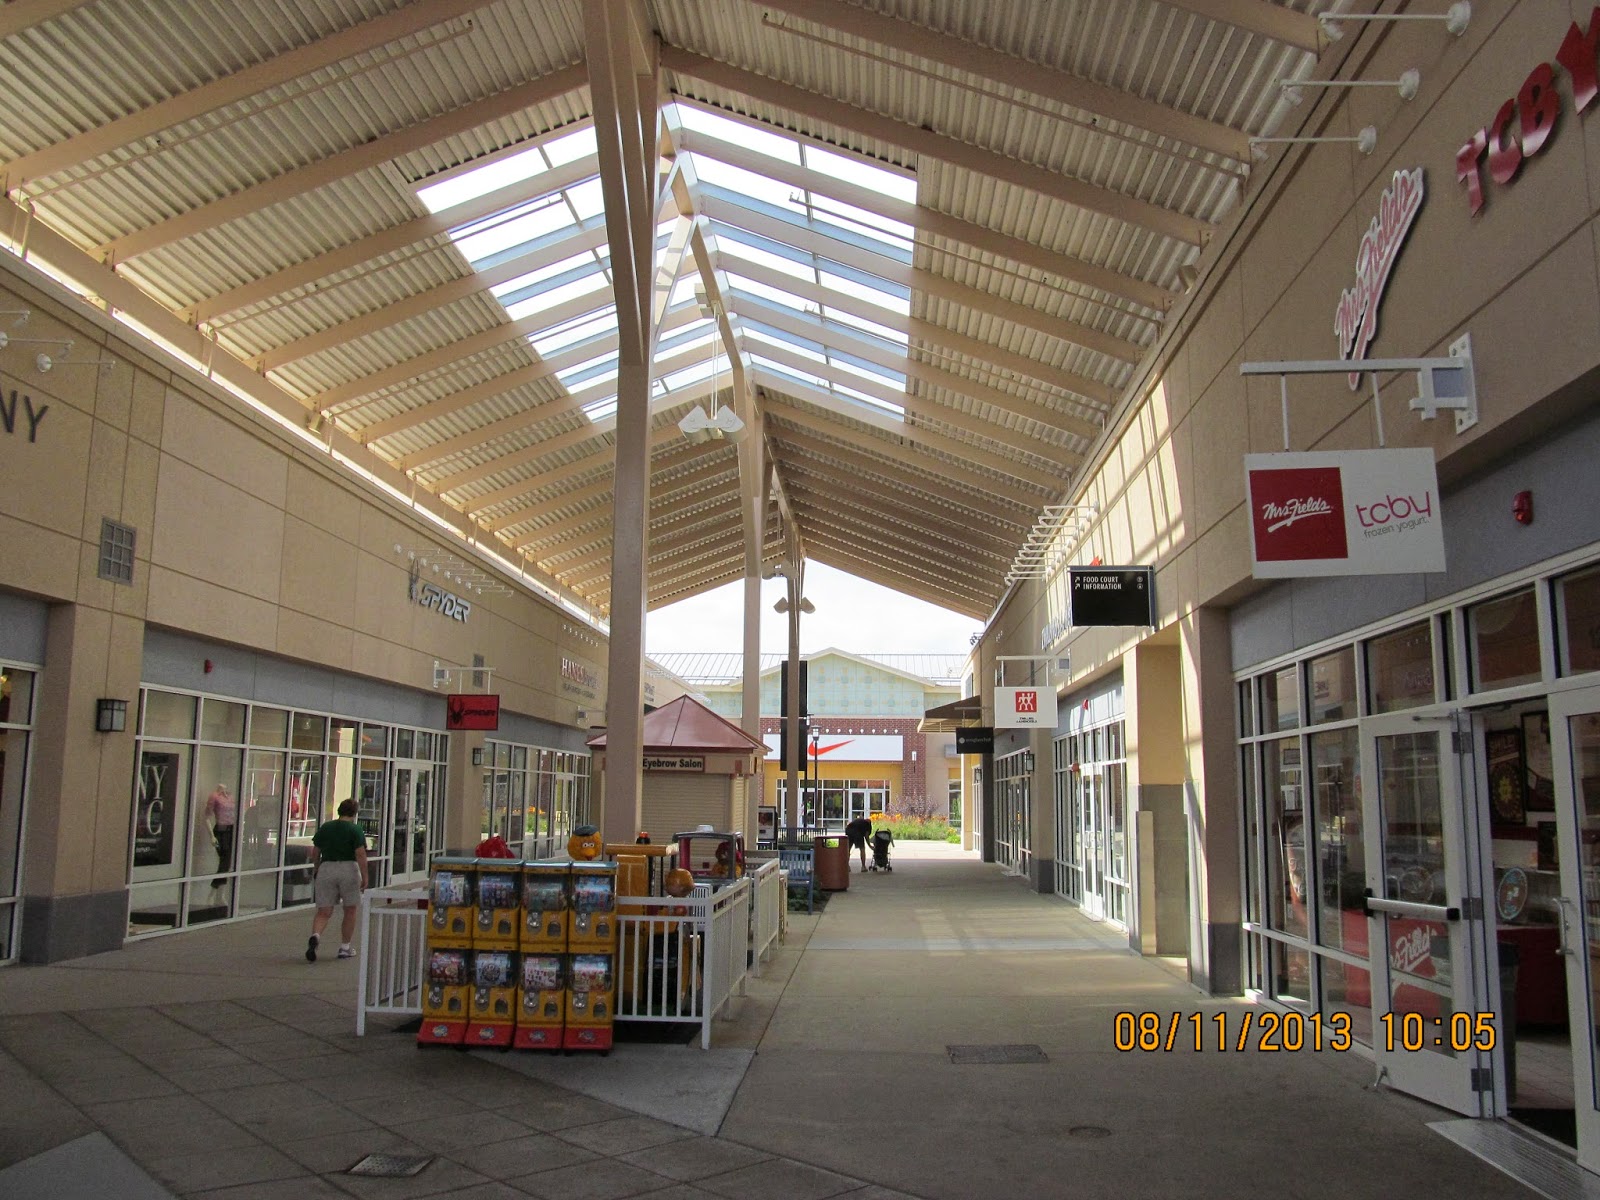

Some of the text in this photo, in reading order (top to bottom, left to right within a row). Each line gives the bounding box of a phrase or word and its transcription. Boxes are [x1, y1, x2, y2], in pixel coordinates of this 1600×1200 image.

[1455, 6, 1600, 219] TCBY
[1356, 491, 1432, 527] tcby
[1363, 525, 1395, 539] frozen
[420, 582, 471, 624] SPYDER
[643, 758, 702, 769] Eyebrow Salon
